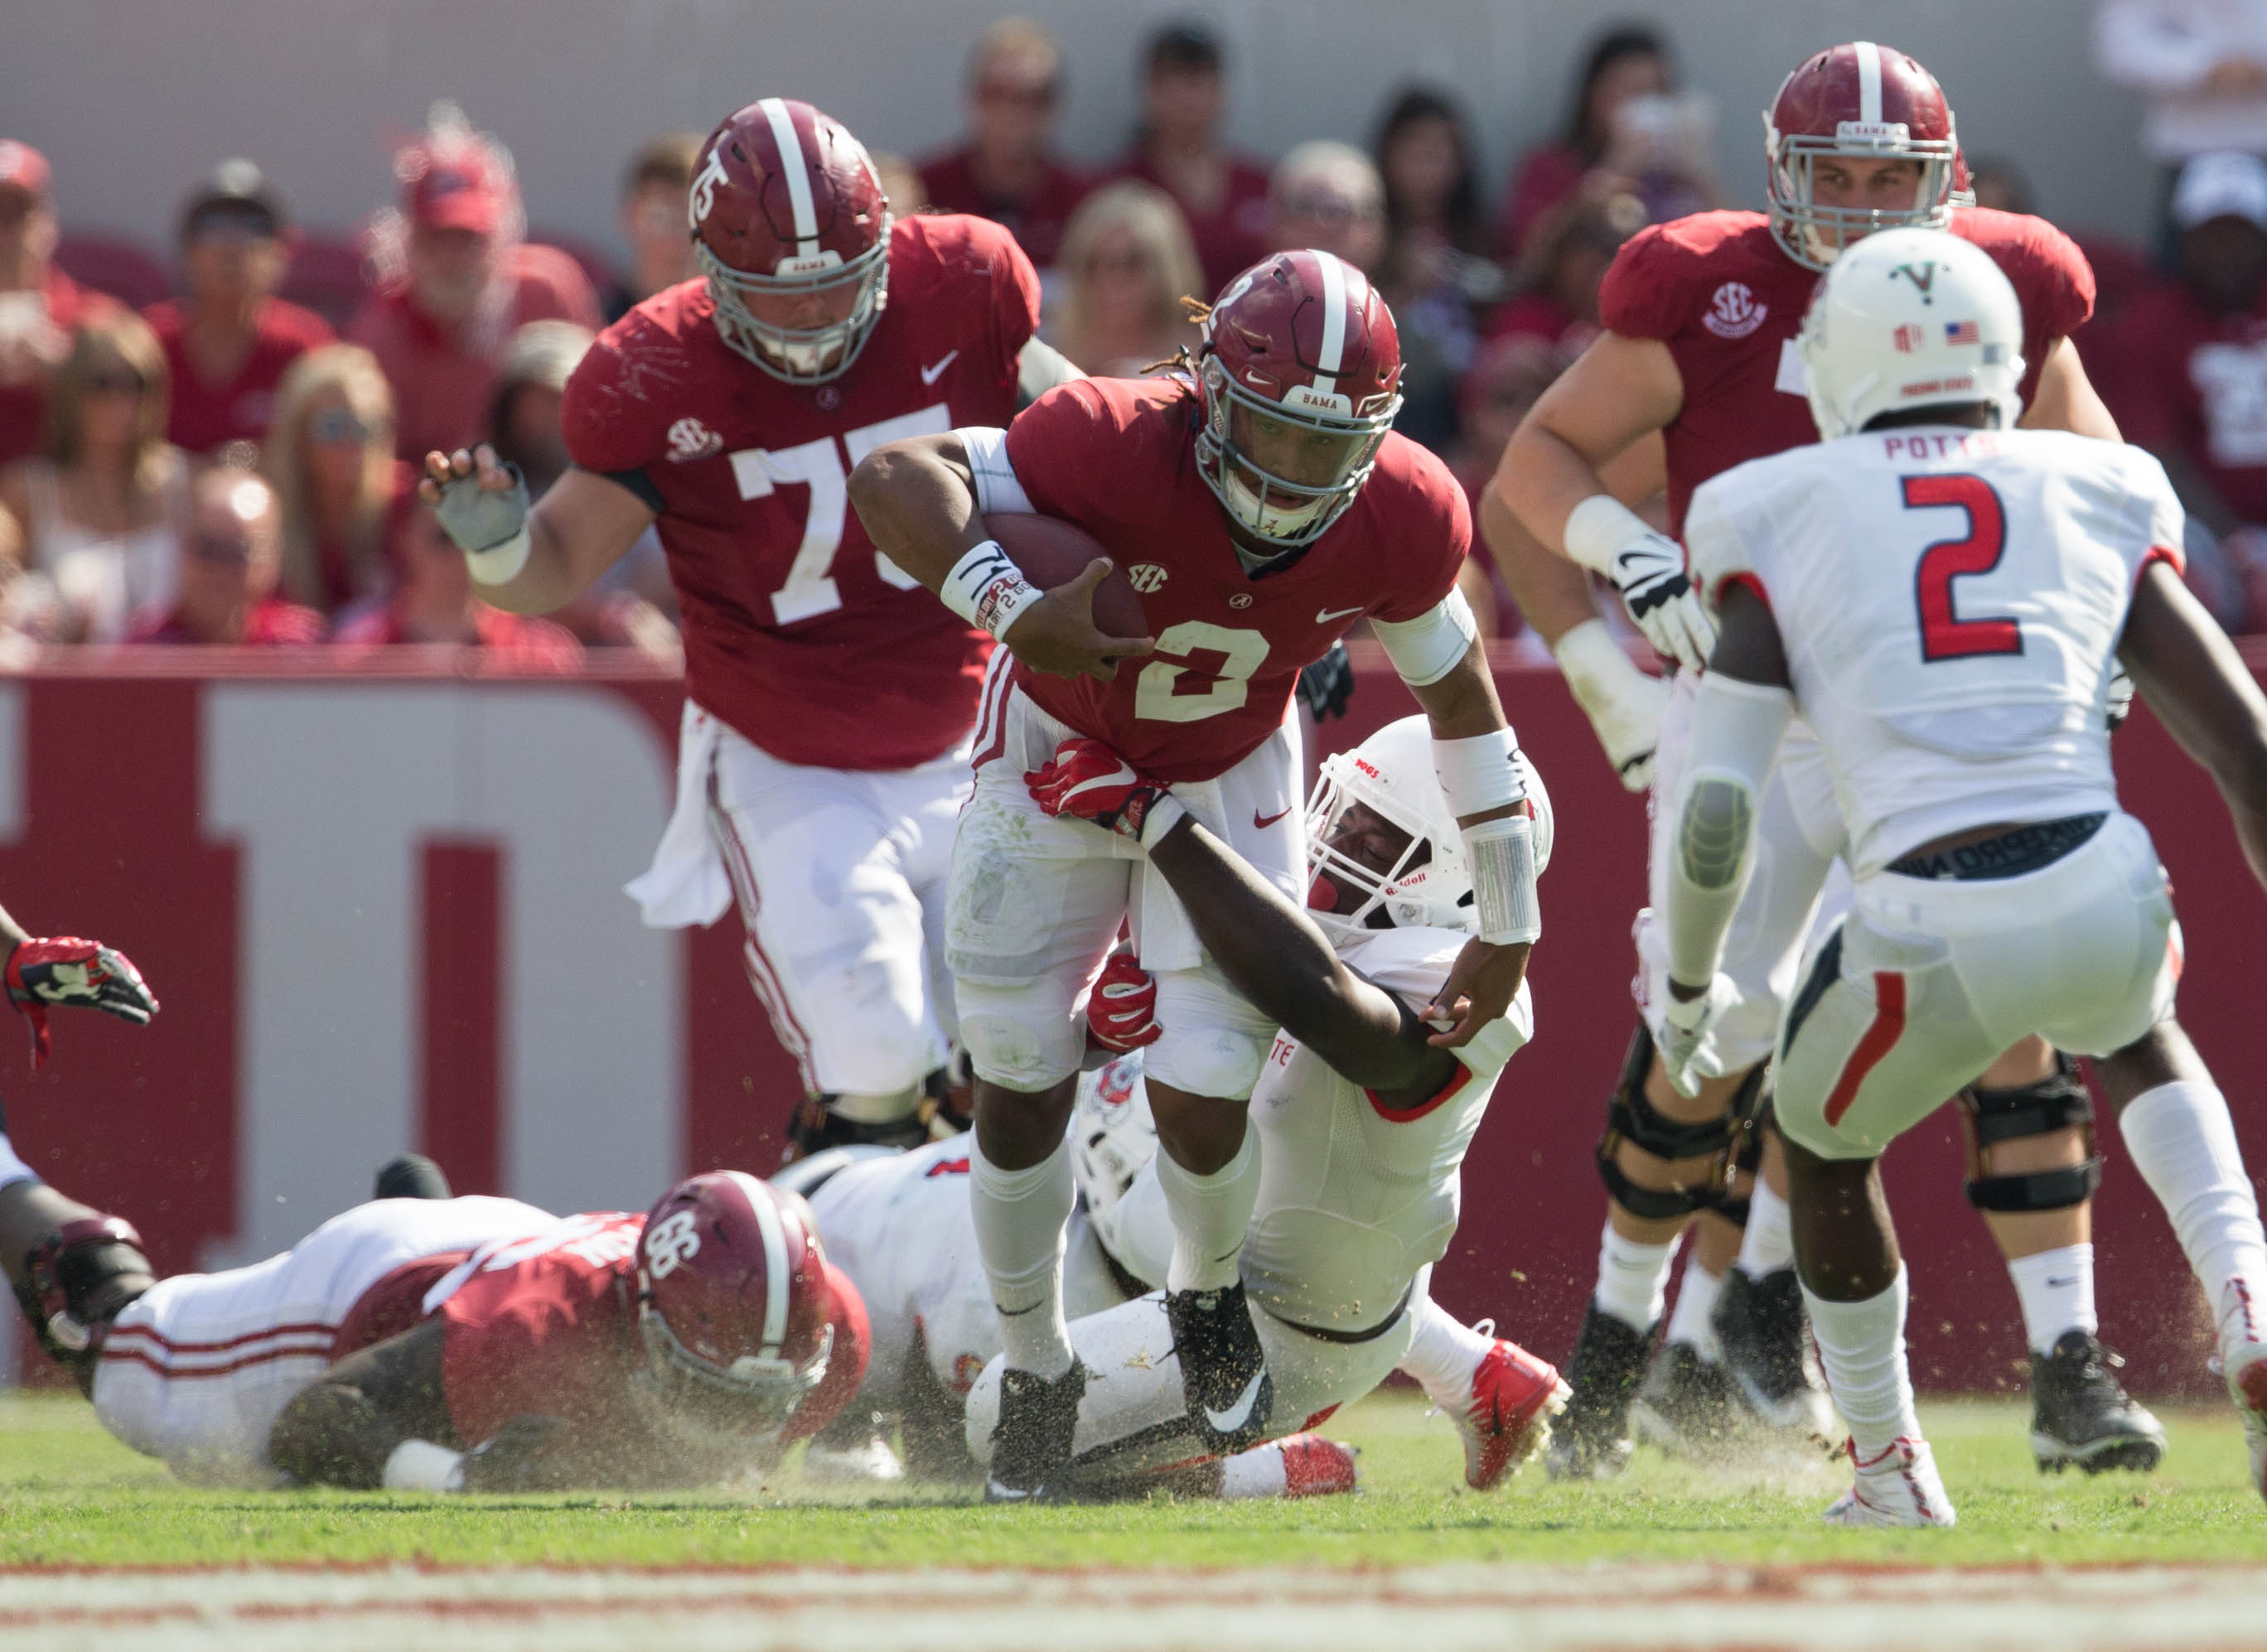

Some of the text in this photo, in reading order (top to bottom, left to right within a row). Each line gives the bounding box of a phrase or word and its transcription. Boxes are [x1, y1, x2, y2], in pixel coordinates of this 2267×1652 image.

[689, 149, 729, 222] 75
[1713, 282, 1753, 321] SEC
[1303, 394, 1337, 409] BAMA
[1884, 434, 1999, 460] POTTS
[1128, 563, 1168, 593] SEC
[1902, 474, 2024, 664] 2
[993, 582, 1004, 600] 2
[1000, 593, 1017, 609] 2
[1134, 620, 1270, 723] 2
[1355, 758, 1380, 780] DOGS
